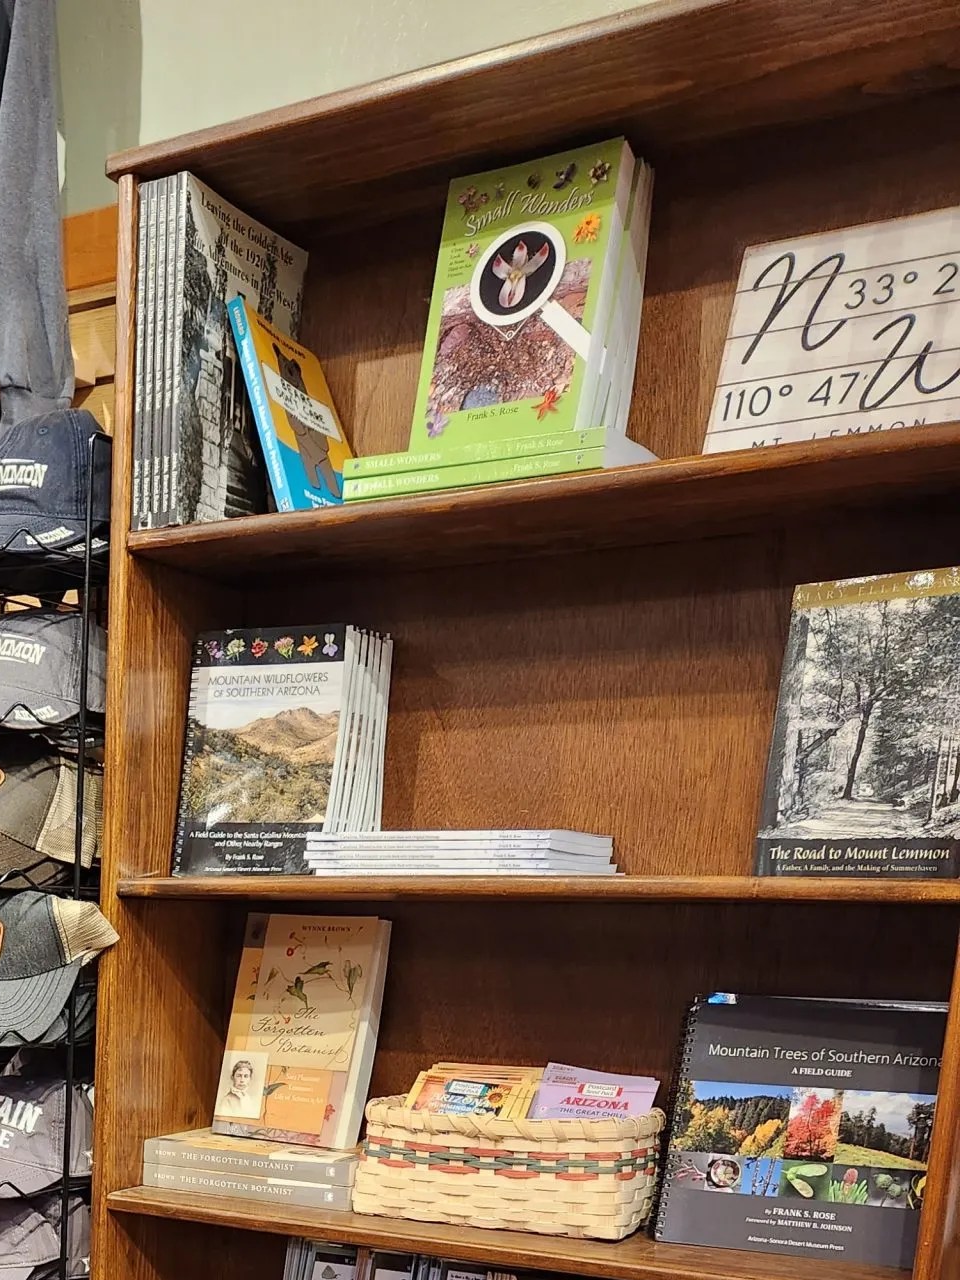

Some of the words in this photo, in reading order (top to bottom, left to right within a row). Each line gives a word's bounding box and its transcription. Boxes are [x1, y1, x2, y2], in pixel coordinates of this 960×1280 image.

[464, 190, 520, 237] Small
[520, 187, 593, 215] Wonders
[201, 192, 231, 229] Leaving
[233, 218, 245, 236] the
[248, 227, 278, 256] Golden
[230, 240, 243, 257] the
[251, 274, 259, 290] in
[742, 252, 848, 365] N
[467, 411, 488, 422] Frank
[490, 409, 497, 418] S.
[499, 406, 519, 416] Rose
[365, 457, 396, 469] SMALL
[396, 453, 441, 467] WONDERS
[394, 474, 440, 489] WONDERS
[208, 675, 261, 686] MOUNTAIN
[264, 672, 329, 684] WILDFLOWERS
[226, 687, 274, 698] SOUTHERN
[276, 685, 321, 696] ARIZONA
[209, 831, 226, 839] Guide
[234, 831, 243, 839] the
[243, 831, 259, 839] Santa
[260, 831, 281, 839] Catalina
[769, 845, 790, 860] The
[793, 845, 826, 860] Road
[829, 847, 842, 860] to
[845, 846, 888, 860] Mount
[891, 846, 950, 860] Lemmon
[832, 864, 844, 872] and
[845, 864, 856, 872] the
[857, 864, 880, 873] Making
[890, 864, 938, 872] Summerhaven
[302, 925, 325, 933] WYNNE
[294, 1006, 320, 1020] The
[252, 1017, 326, 1046] Forgotten
[276, 1038, 350, 1064] Botanist
[708, 1043, 770, 1058] Mountain
[773, 1046, 808, 1061] Trees
[811, 1048, 825, 1062] of
[828, 1049, 890, 1065] Southern
[799, 1067, 824, 1076] FIELD
[825, 1069, 852, 1078] GUIDE
[560, 1096, 629, 1110] ARIZONA
[575, 1108, 600, 1116] GREAT
[181, 1152, 197, 1161] THE
[200, 1153, 250, 1166] FORGOTTEN
[252, 1160, 295, 1172] BOTANIST
[179, 1175, 196, 1184] THE
[198, 1177, 248, 1190] FORGOTTEN
[251, 1184, 294, 1196] BOTANIST
[773, 1207, 802, 1218] FRANK
[804, 1209, 811, 1218] S.
[813, 1211, 836, 1221] ROSE
[777, 1219, 811, 1229] MATTHEW
[820, 1223, 852, 1233] JOHNSON
[829, 1243, 844, 1251] Press
